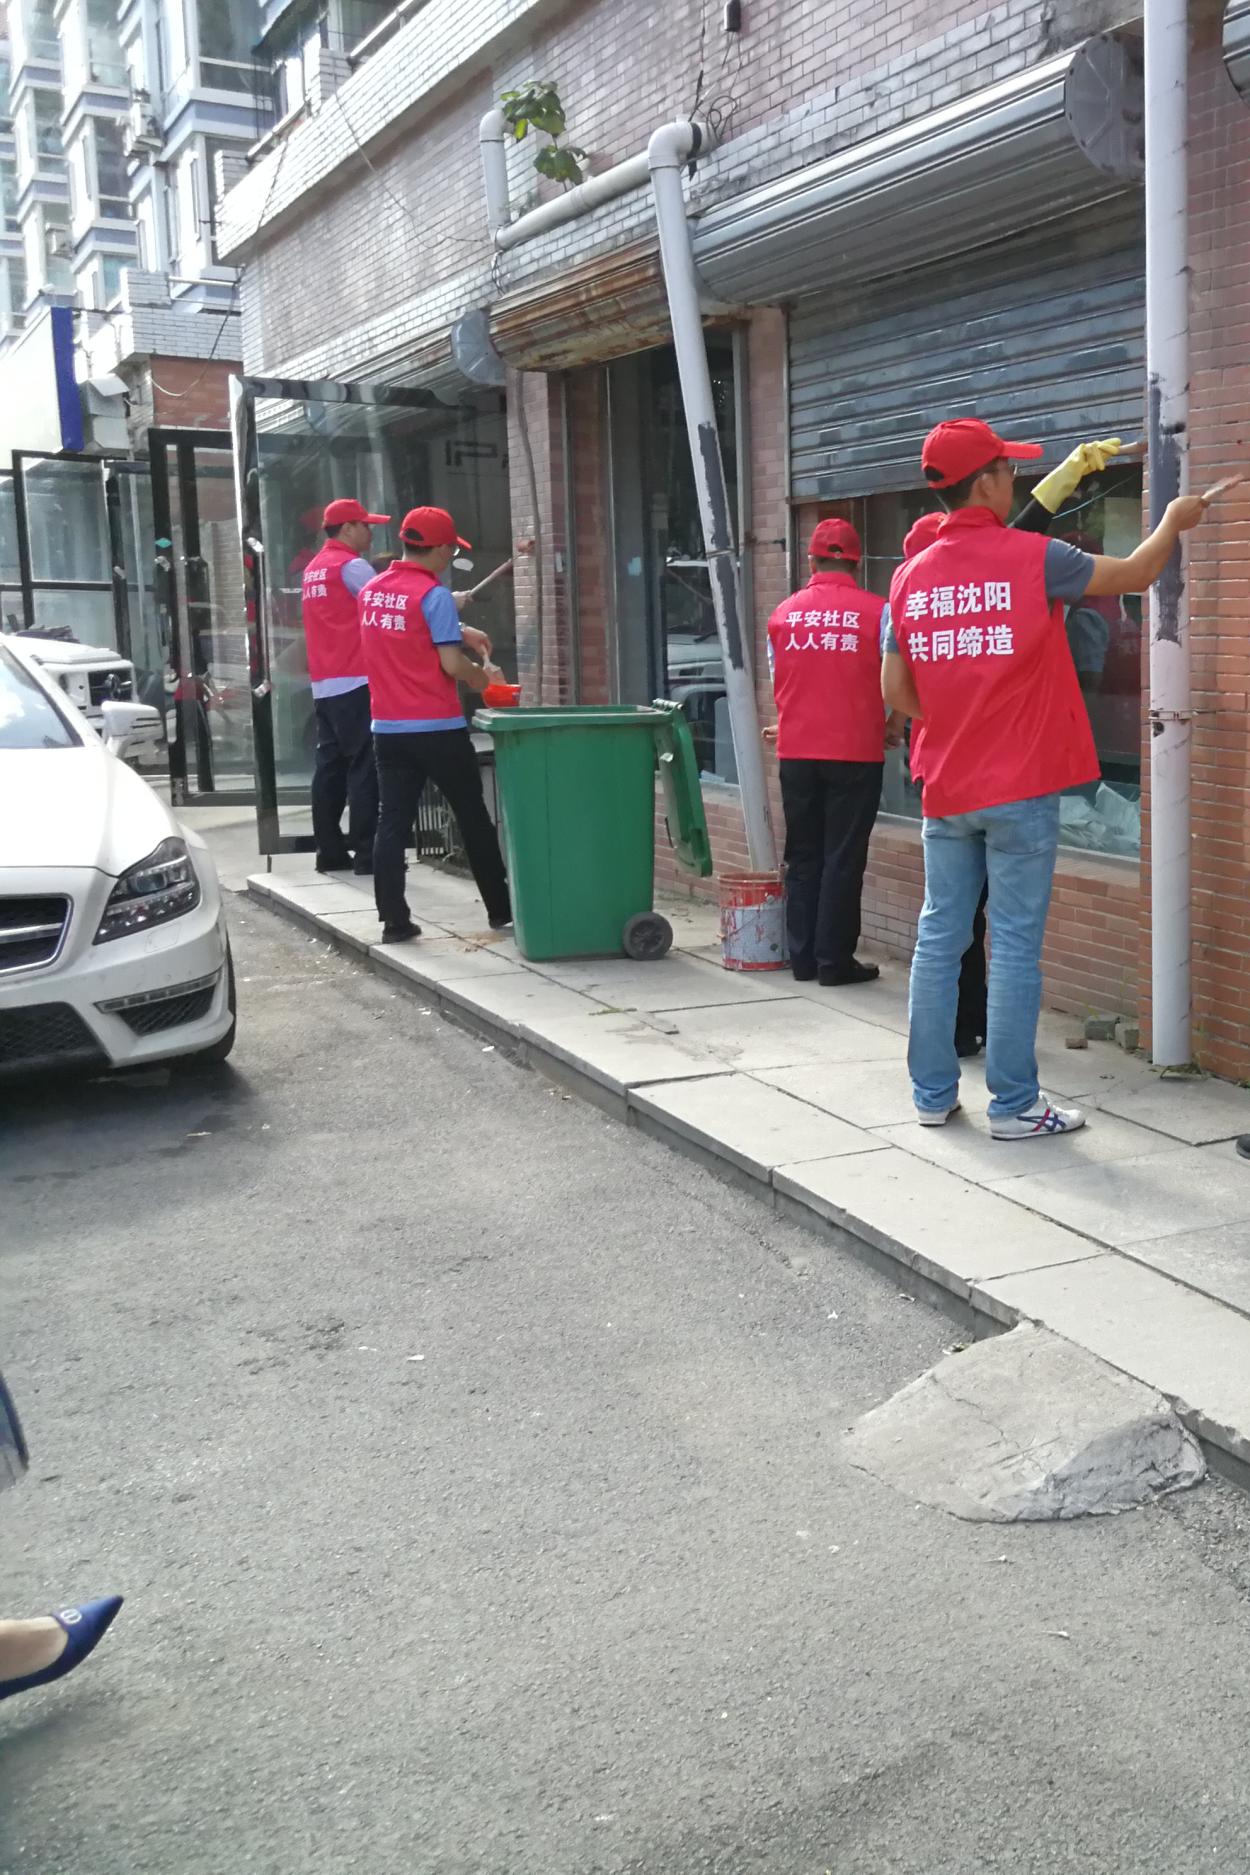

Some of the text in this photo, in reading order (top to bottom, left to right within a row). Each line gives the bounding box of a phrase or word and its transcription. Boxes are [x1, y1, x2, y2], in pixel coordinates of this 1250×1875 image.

[362, 589, 409, 611] 平安社区
[905, 582, 1012, 621] 幸福沈阳
[361, 610, 406, 632] 人人有责
[785, 609, 861, 629] 平安社区
[785, 632, 859, 653] 人人有责
[908, 624, 1014, 663] 共同缔造
